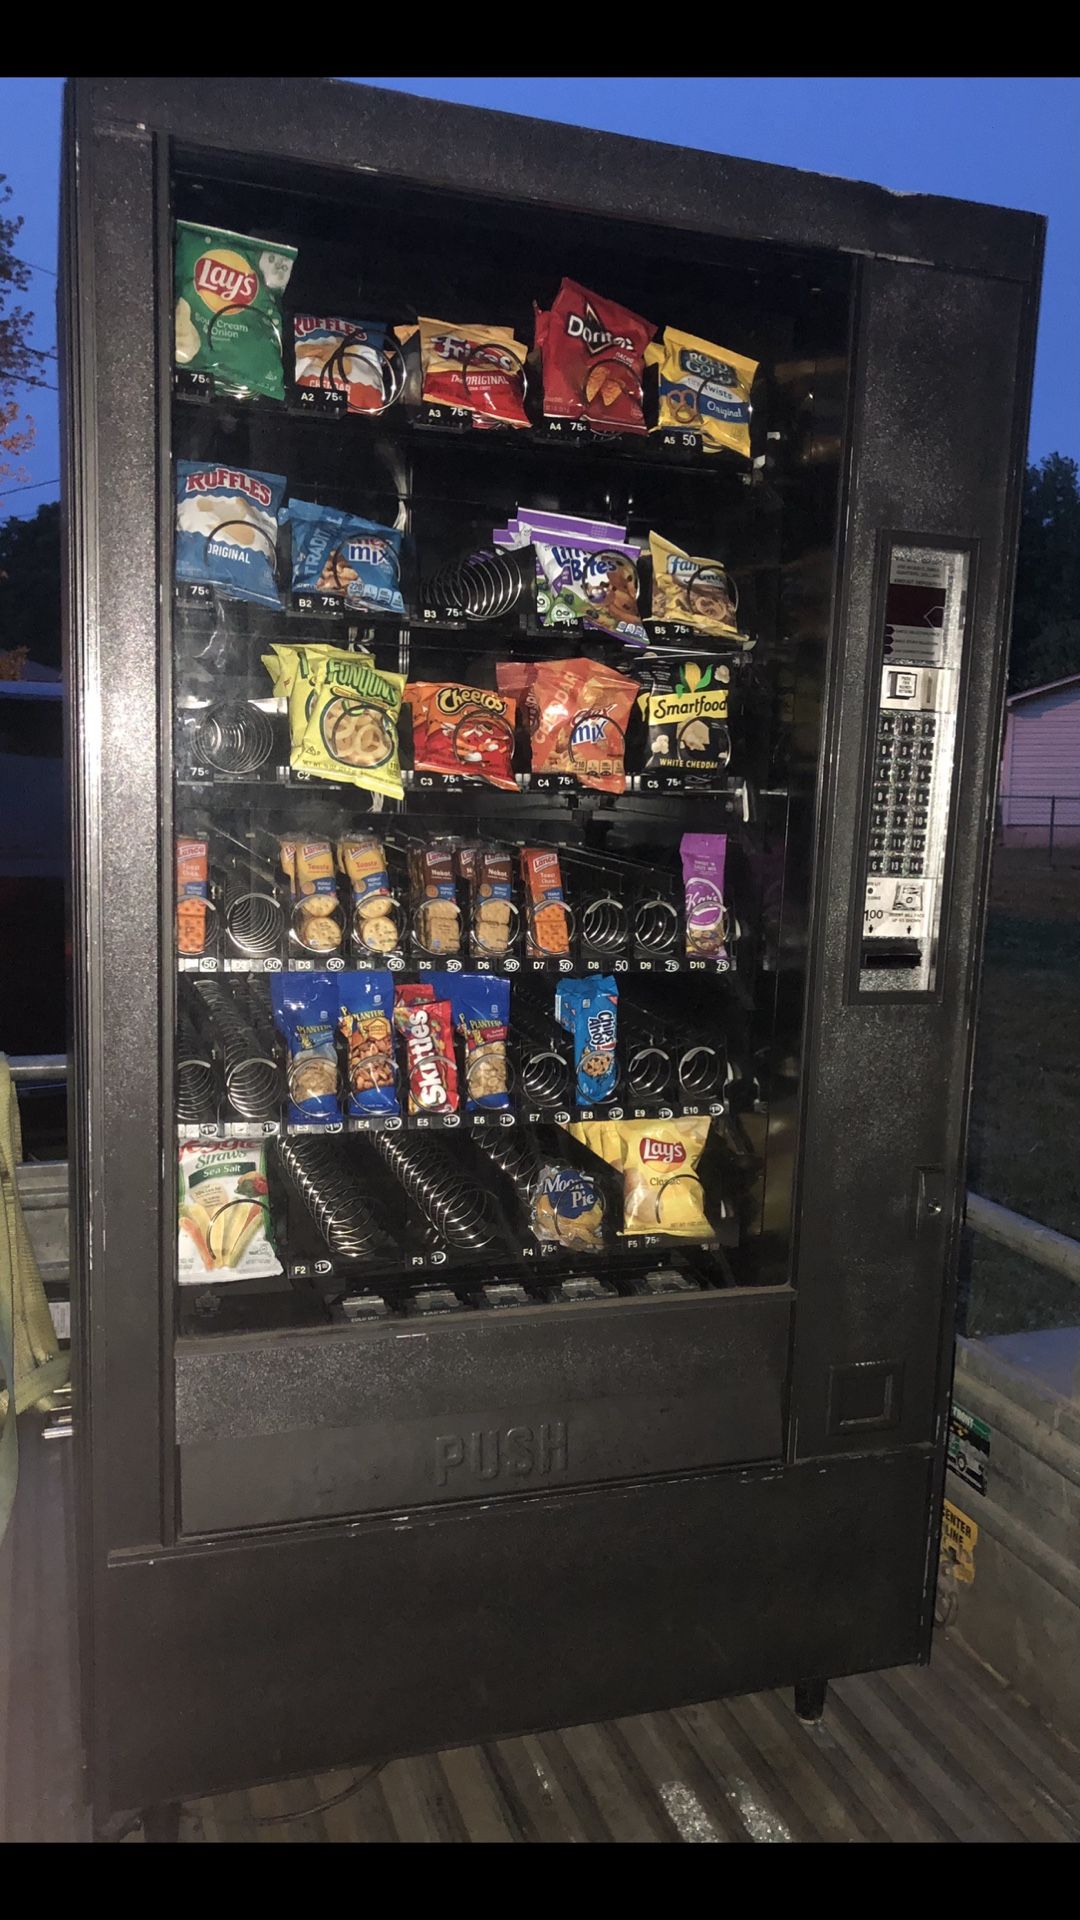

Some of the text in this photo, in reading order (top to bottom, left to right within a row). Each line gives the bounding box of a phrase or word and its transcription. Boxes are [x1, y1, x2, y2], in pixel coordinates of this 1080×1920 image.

[198, 260, 254, 301] Lay's
[217, 320, 248, 333] Cream
[211, 327, 239, 338] Onion
[568, 314, 634, 351] Doritos
[466, 375, 510, 385] ORIGINAL
[301, 392, 314, 402] A2
[428, 409, 441, 417] A3
[707, 400, 743, 418] Original
[664, 434, 696, 446] A5 50
[186, 468, 272, 506] RUFFLES
[207, 542, 251, 565] ORIGINAL
[349, 543, 390, 566] mix
[299, 599, 312, 607] B2
[424, 610, 436, 618] B3
[654, 626, 666, 634] B5
[325, 658, 398, 707] FUNYUNS
[654, 696, 727, 719] Smartfood
[572, 719, 608, 744] mix
[297, 771, 310, 780] C2
[421, 778, 433, 786] C3
[538, 779, 549, 787] C4
[267, 961, 279, 969] 50
[330, 961, 341, 969] 50
[391, 961, 402, 969] 50
[447, 962, 458, 970] 50
[506, 961, 517, 970] 50
[560, 962, 571, 970] 50
[615, 960, 628, 971] 50
[667, 961, 677, 970] 75
[717, 961, 727, 970] 75
[598, 1011, 614, 1043] Chips
[409, 1010, 447, 1105] Skittles
[530, 1114, 539, 1122] E7
[643, 1138, 683, 1163] Lay's
[195, 1151, 247, 1168] Straws
[203, 1164, 241, 1176] Sea Salt
[650, 1176, 681, 1187] Classic
[570, 1191, 594, 1209] Pie
[628, 1240, 638, 1248] F5
[523, 1248, 534, 1256] F4
[295, 1266, 306, 1274] F2
[435, 1421, 568, 1487] PUSH
[942, 1507, 972, 1540] ENTER
[946, 1525, 964, 1547] LINE
